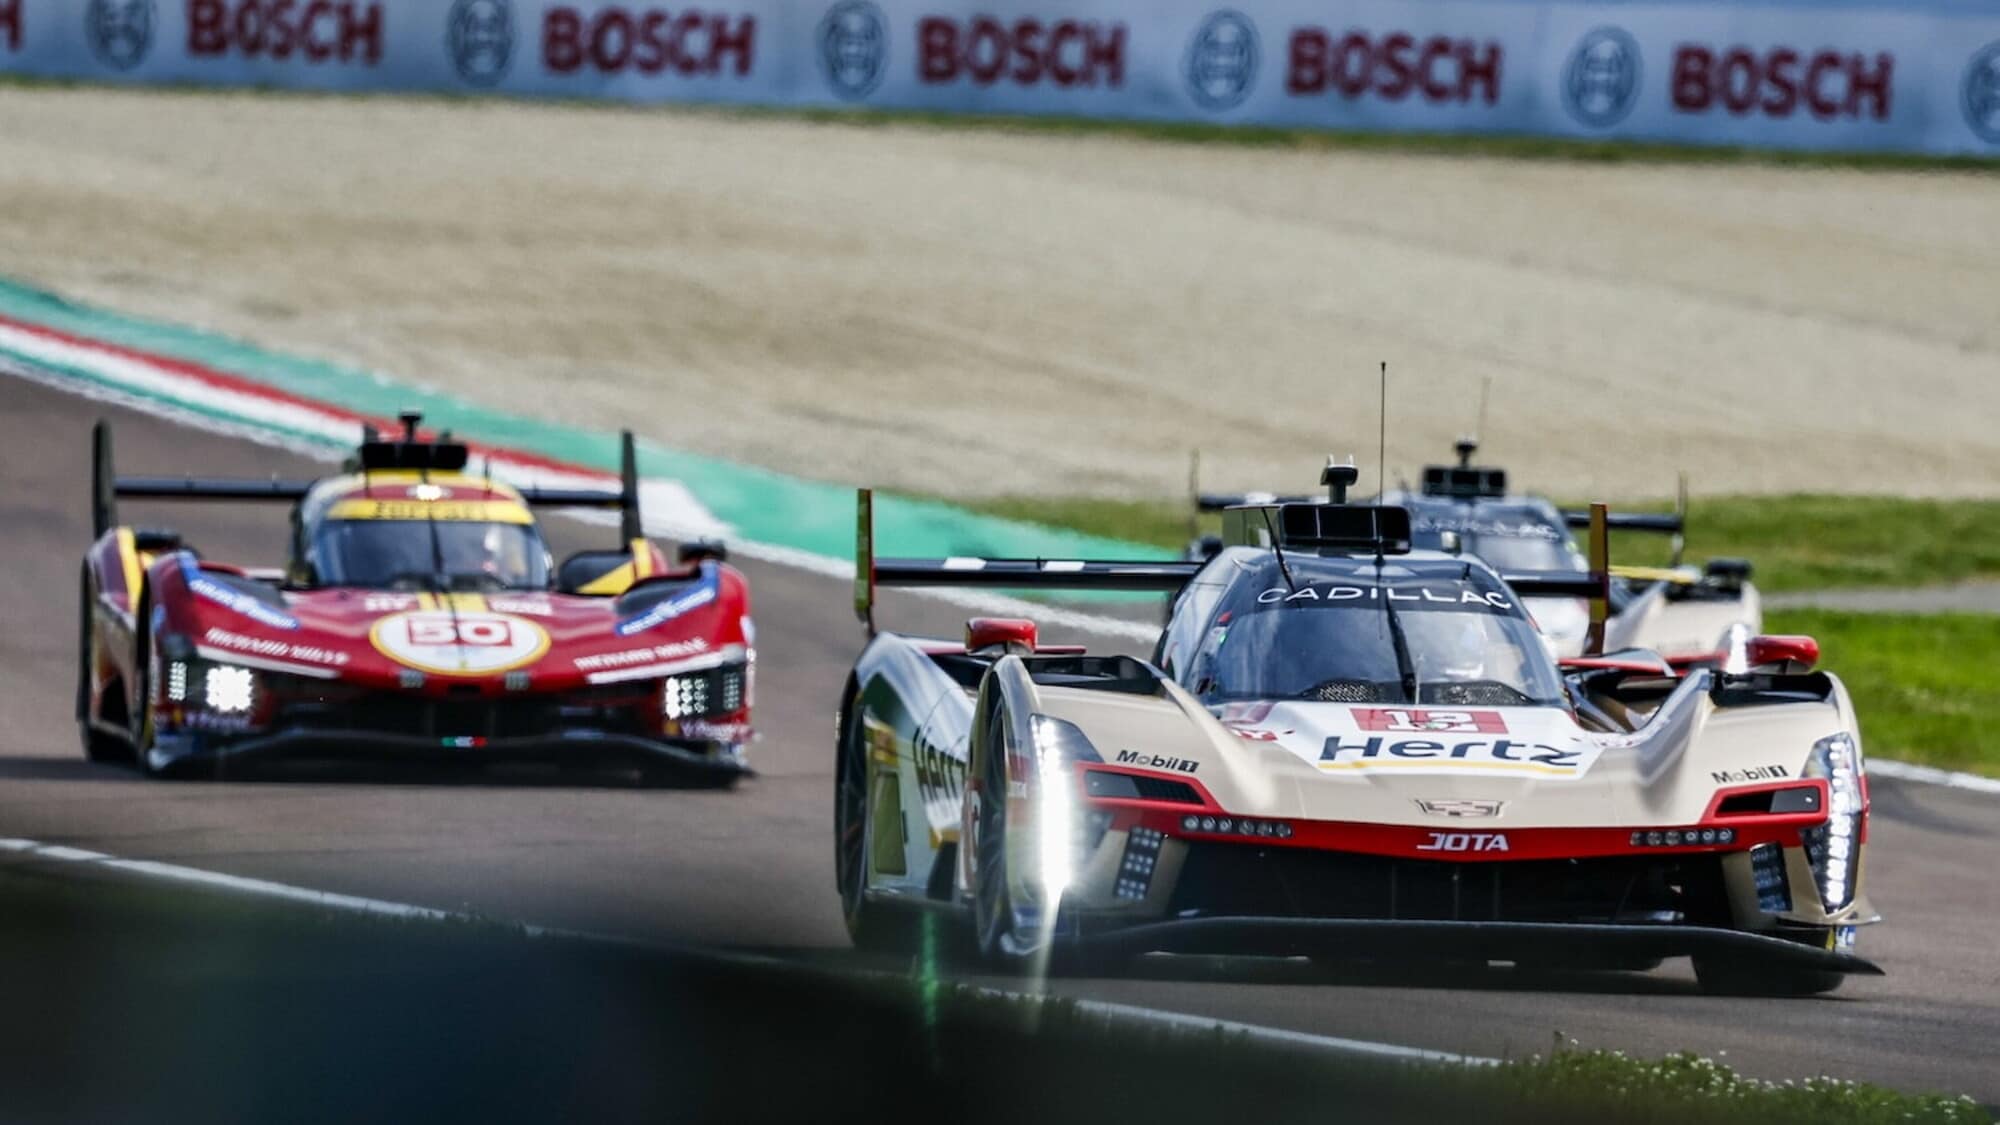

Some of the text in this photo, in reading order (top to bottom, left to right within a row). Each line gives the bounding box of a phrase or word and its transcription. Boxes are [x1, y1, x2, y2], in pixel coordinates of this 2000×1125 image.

[187, 0, 383, 63] BOSCH
[543, 8, 755, 75] BOSCH
[917, 17, 1124, 88] BOSCH
[1287, 29, 1500, 103] BOSCH
[1672, 46, 1891, 118] BOSCH
[1257, 587, 1512, 609] CADILLAC
[409, 617, 509, 645] 50
[1319, 735, 1582, 767] Hertz
[1416, 833, 1509, 851] JOTA
